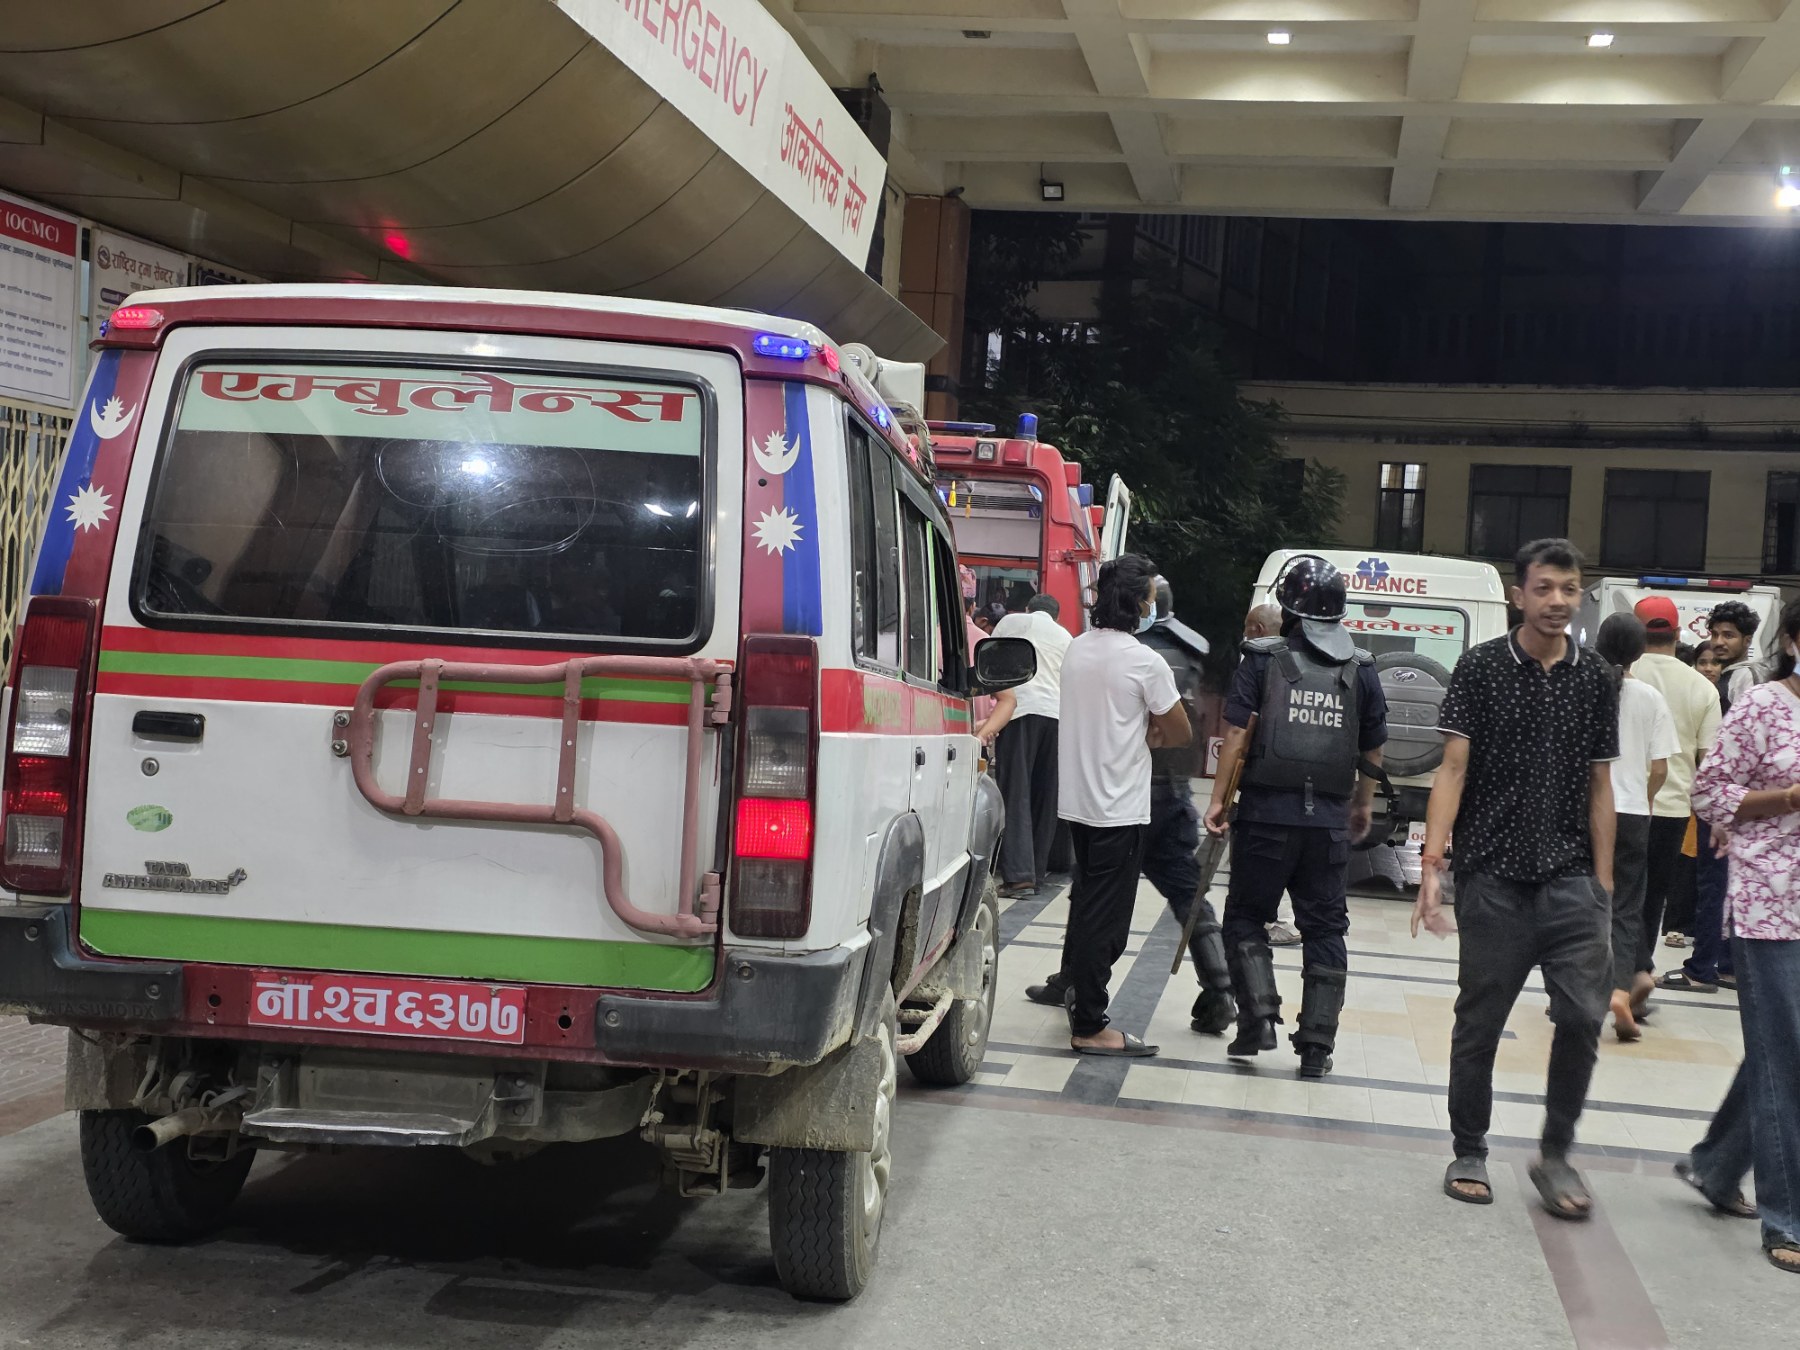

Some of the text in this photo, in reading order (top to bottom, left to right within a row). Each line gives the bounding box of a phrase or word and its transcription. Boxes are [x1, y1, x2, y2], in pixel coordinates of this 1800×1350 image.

[781, 102, 867, 237] आकस्मिक सेवा
[5, 211, 59, 243] (OCMC)
[197, 371, 697, 422] एम्बुलेन्स
[1340, 573, 1428, 595] BULANCE
[1341, 619, 1457, 636] बुलेन्स
[1290, 689, 1344, 710] NEPAL
[1289, 707, 1343, 728] POLICE
[145, 860, 191, 877] TATA
